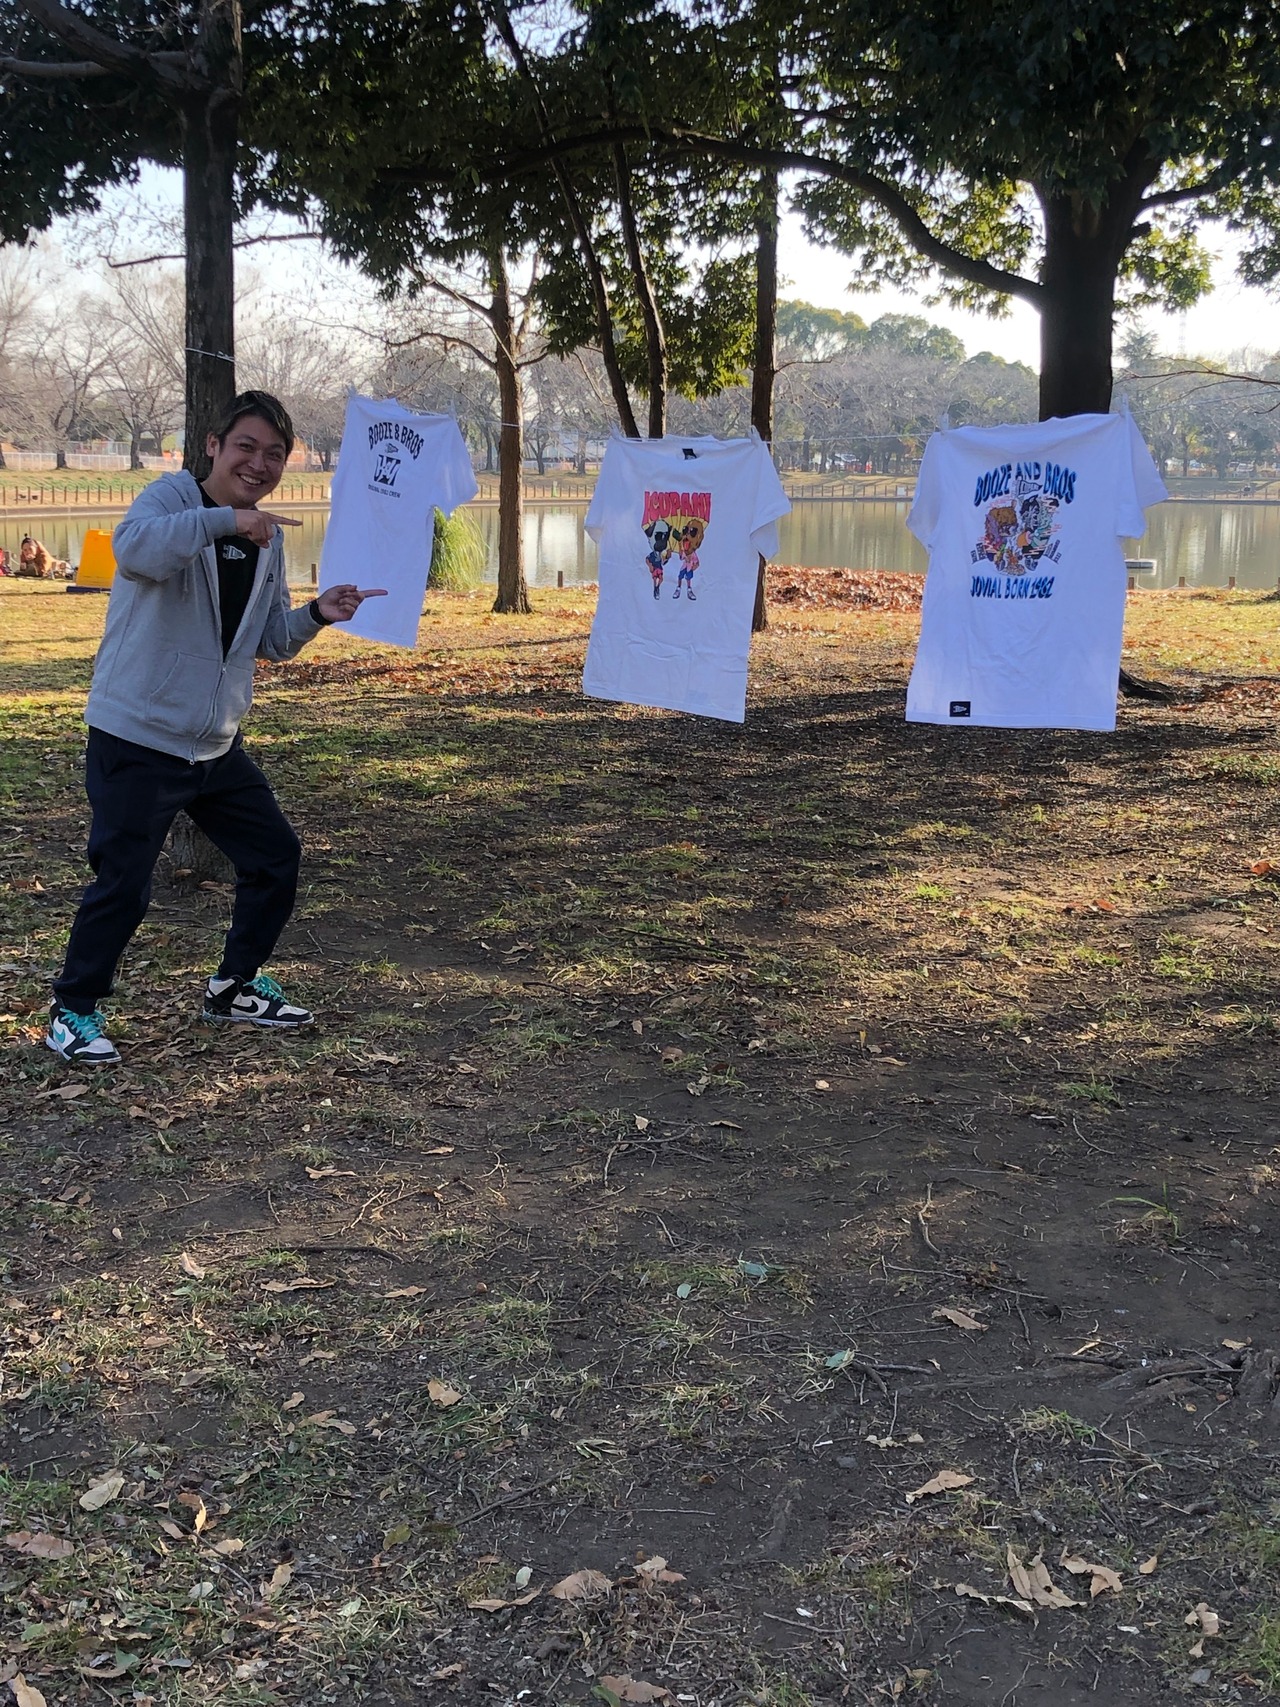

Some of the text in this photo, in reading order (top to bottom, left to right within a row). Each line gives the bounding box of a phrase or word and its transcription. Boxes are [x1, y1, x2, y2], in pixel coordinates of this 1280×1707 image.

[368, 422, 424, 460] BOOZE & BROS
[974, 461, 1076, 507] BOOZE AND BROS
[970, 576, 1002, 598] JOVIAL
[1004, 577, 1032, 599] BORN
